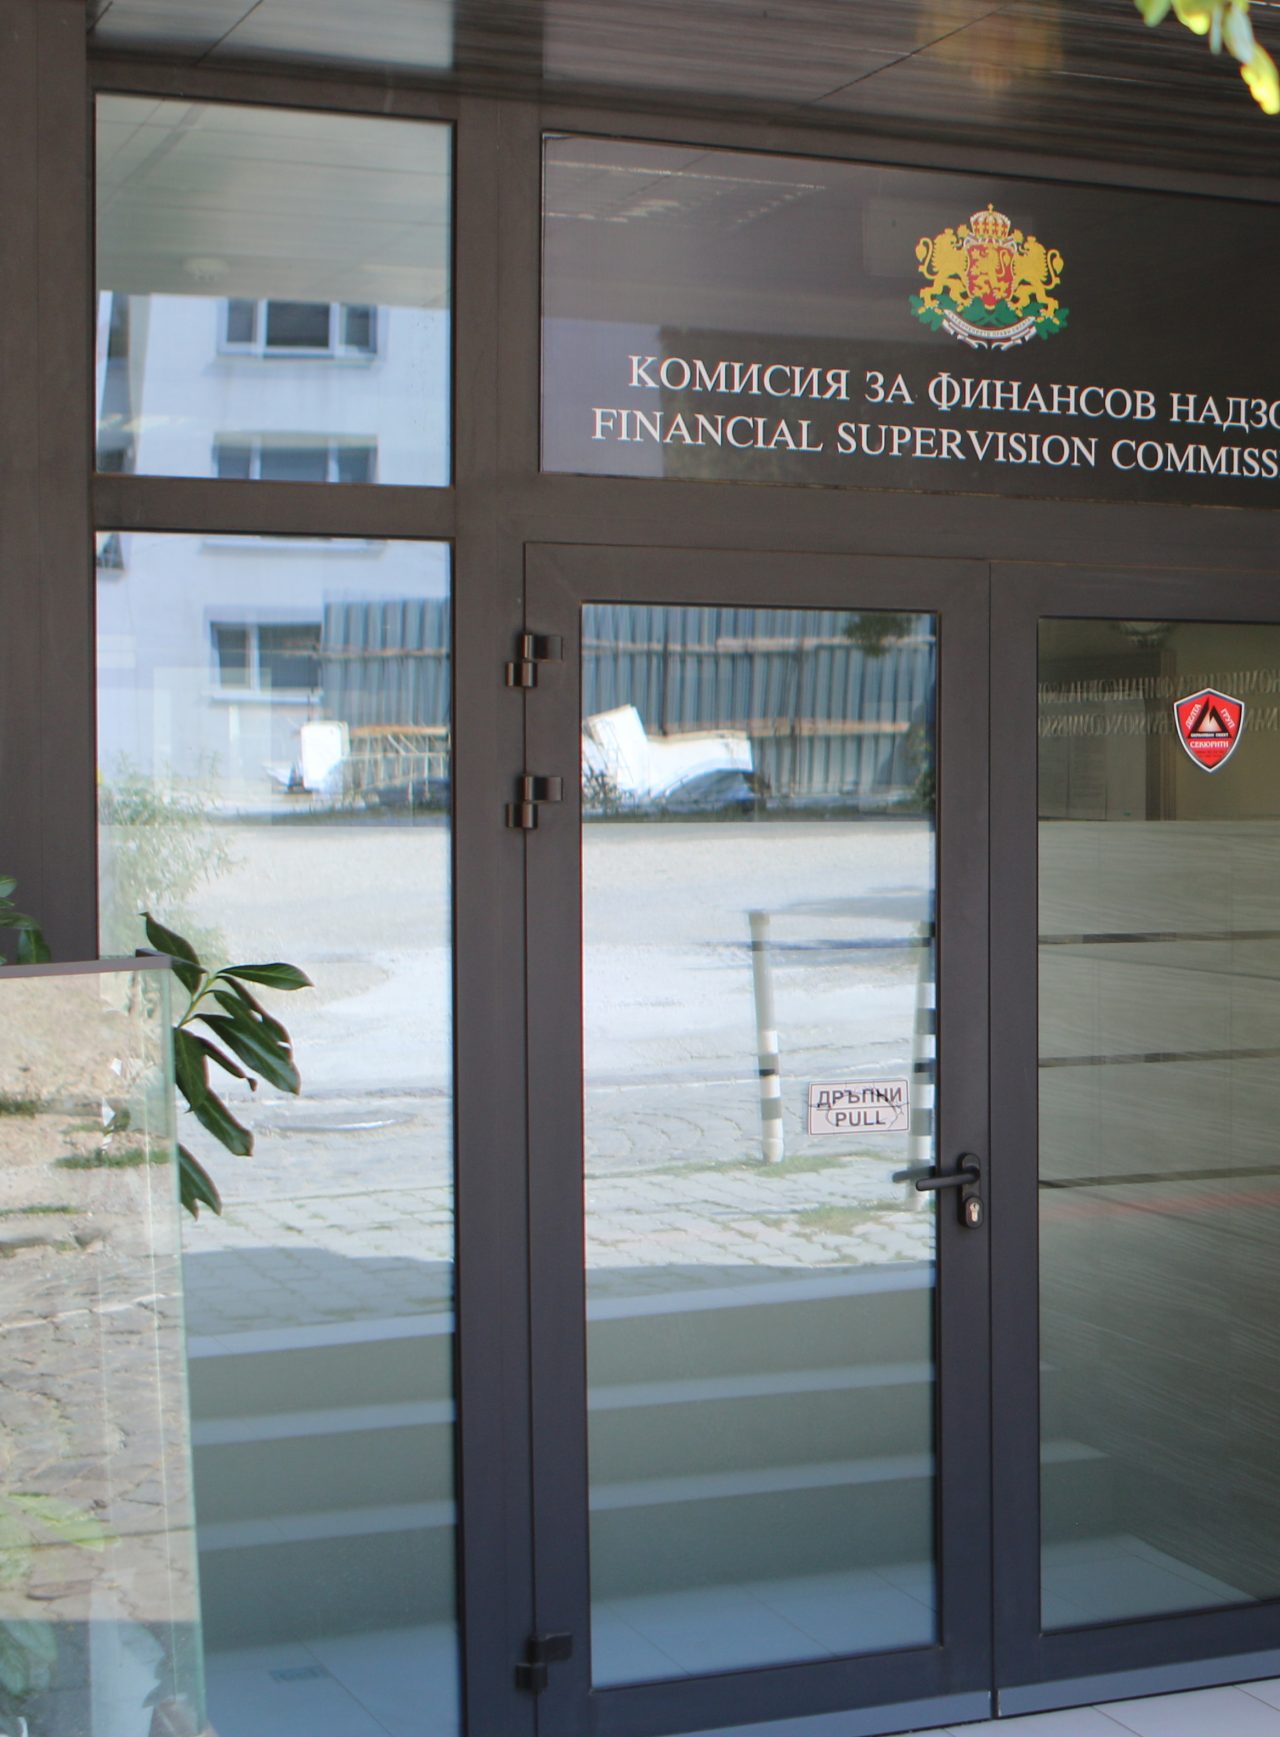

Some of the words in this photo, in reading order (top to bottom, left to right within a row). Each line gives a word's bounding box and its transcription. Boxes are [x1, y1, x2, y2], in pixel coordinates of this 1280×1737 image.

[627, 354, 850, 400] КОМИСИЯ
[864, 371, 915, 405] ЗА
[928, 371, 1156, 420] ФИНАНСОВ
[591, 407, 824, 452] FINANCIAL
[836, 421, 1099, 467] SUPERVISION
[817, 1087, 902, 1108] ДРЪПНИ
[835, 1110, 886, 1127] PULL
